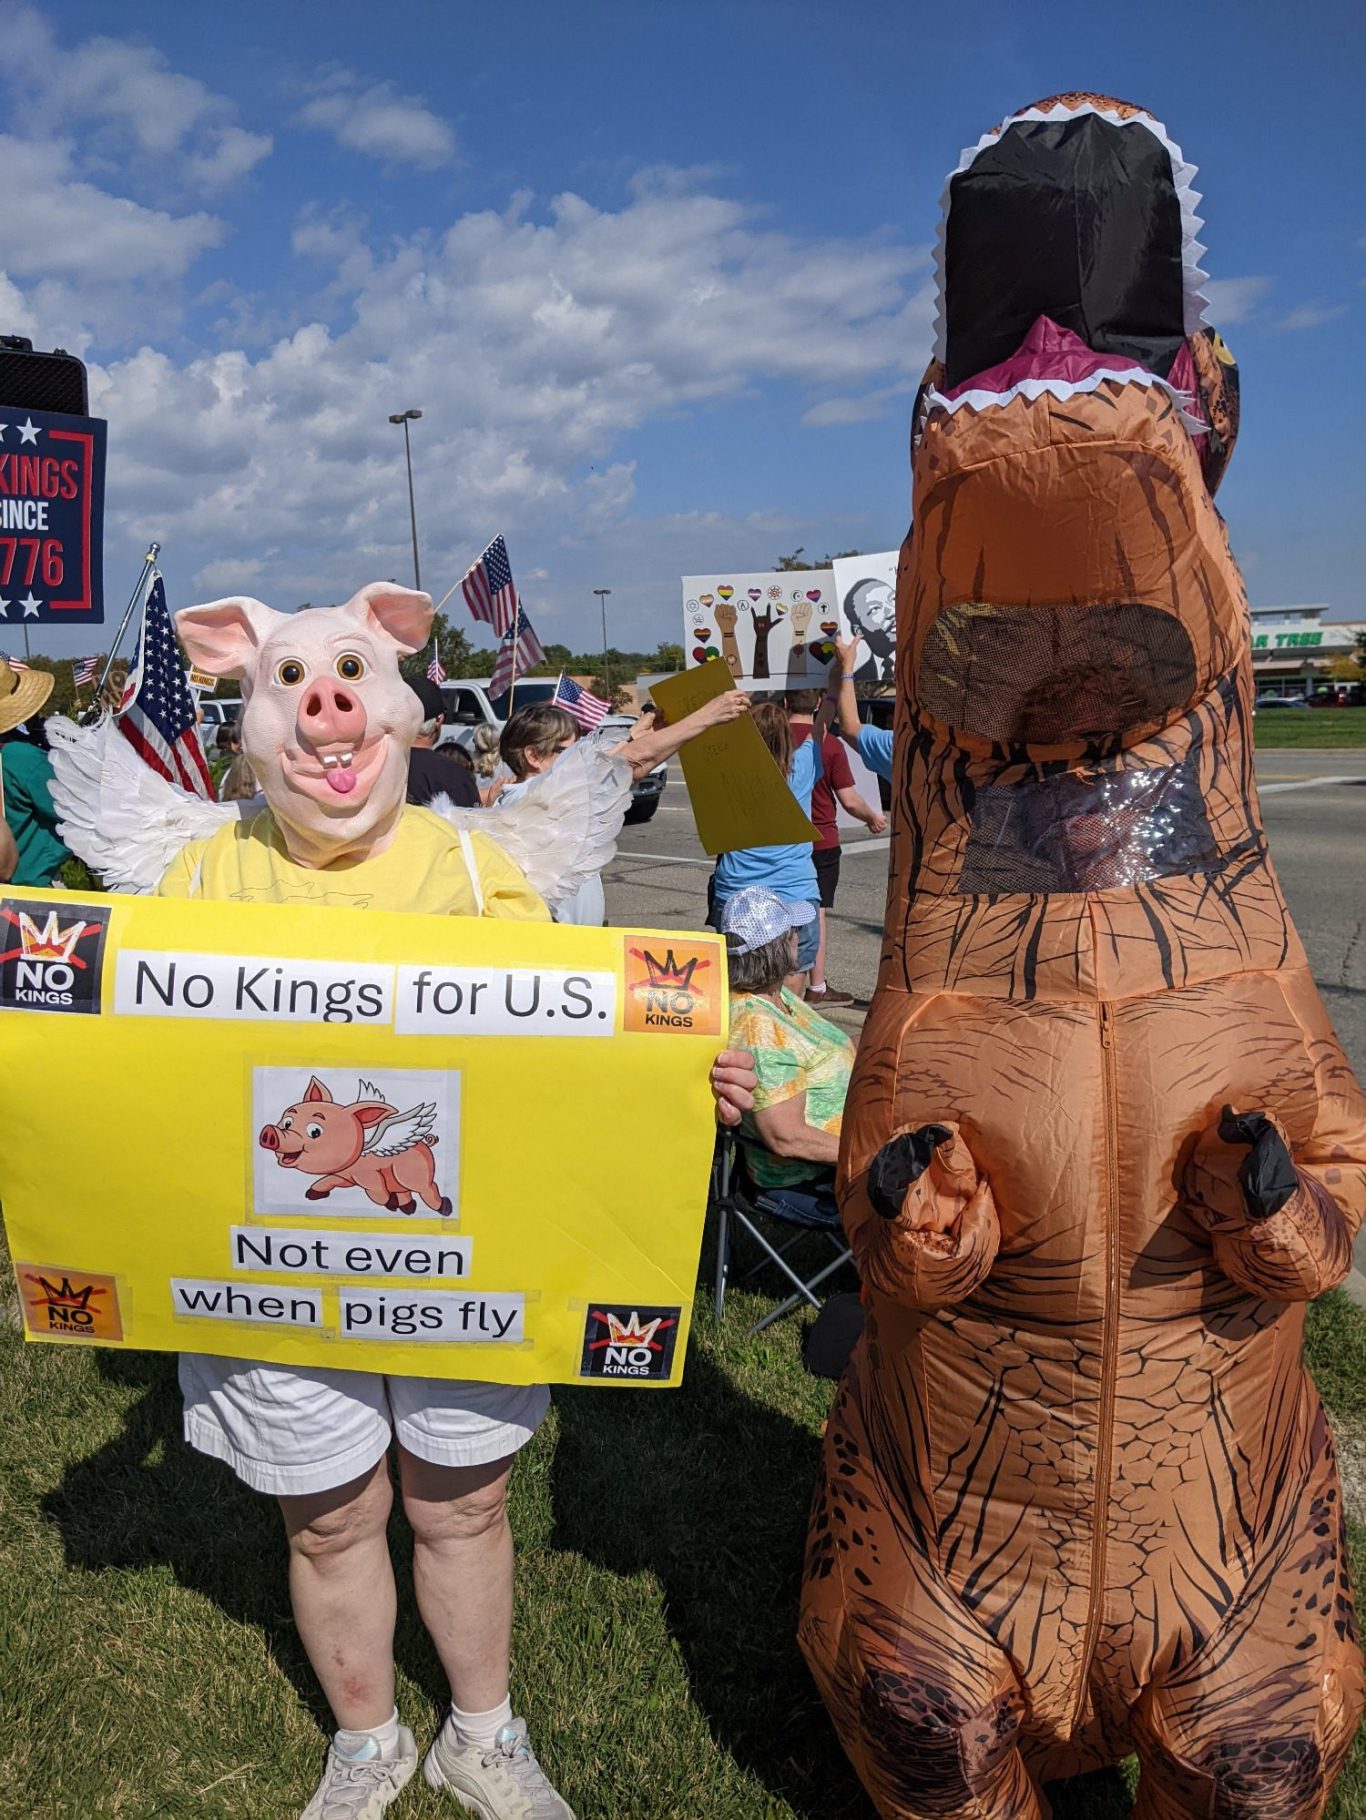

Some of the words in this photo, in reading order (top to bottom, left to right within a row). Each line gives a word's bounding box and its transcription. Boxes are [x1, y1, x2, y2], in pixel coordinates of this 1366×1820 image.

[0, 499, 49, 531] INCE
[1275, 632, 1323, 647] TREE
[16, 961, 75, 991] NO
[15, 989, 73, 1005] KINGS
[136, 961, 214, 1008] No
[235, 967, 383, 1023] Kings
[412, 971, 488, 1014] for
[505, 974, 607, 1019] U.S.
[646, 990, 694, 1015] NO
[645, 1014, 693, 1027] KINGS
[237, 1234, 329, 1269] Not
[345, 1246, 464, 1275] even
[48, 1306, 94, 1325] NO
[179, 1286, 316, 1323] when
[346, 1297, 443, 1335] pigs
[459, 1301, 517, 1338] fly
[49, 1321, 95, 1334] KINGS
[604, 1347, 652, 1366] NO
[602, 1365, 650, 1375] KINGS
